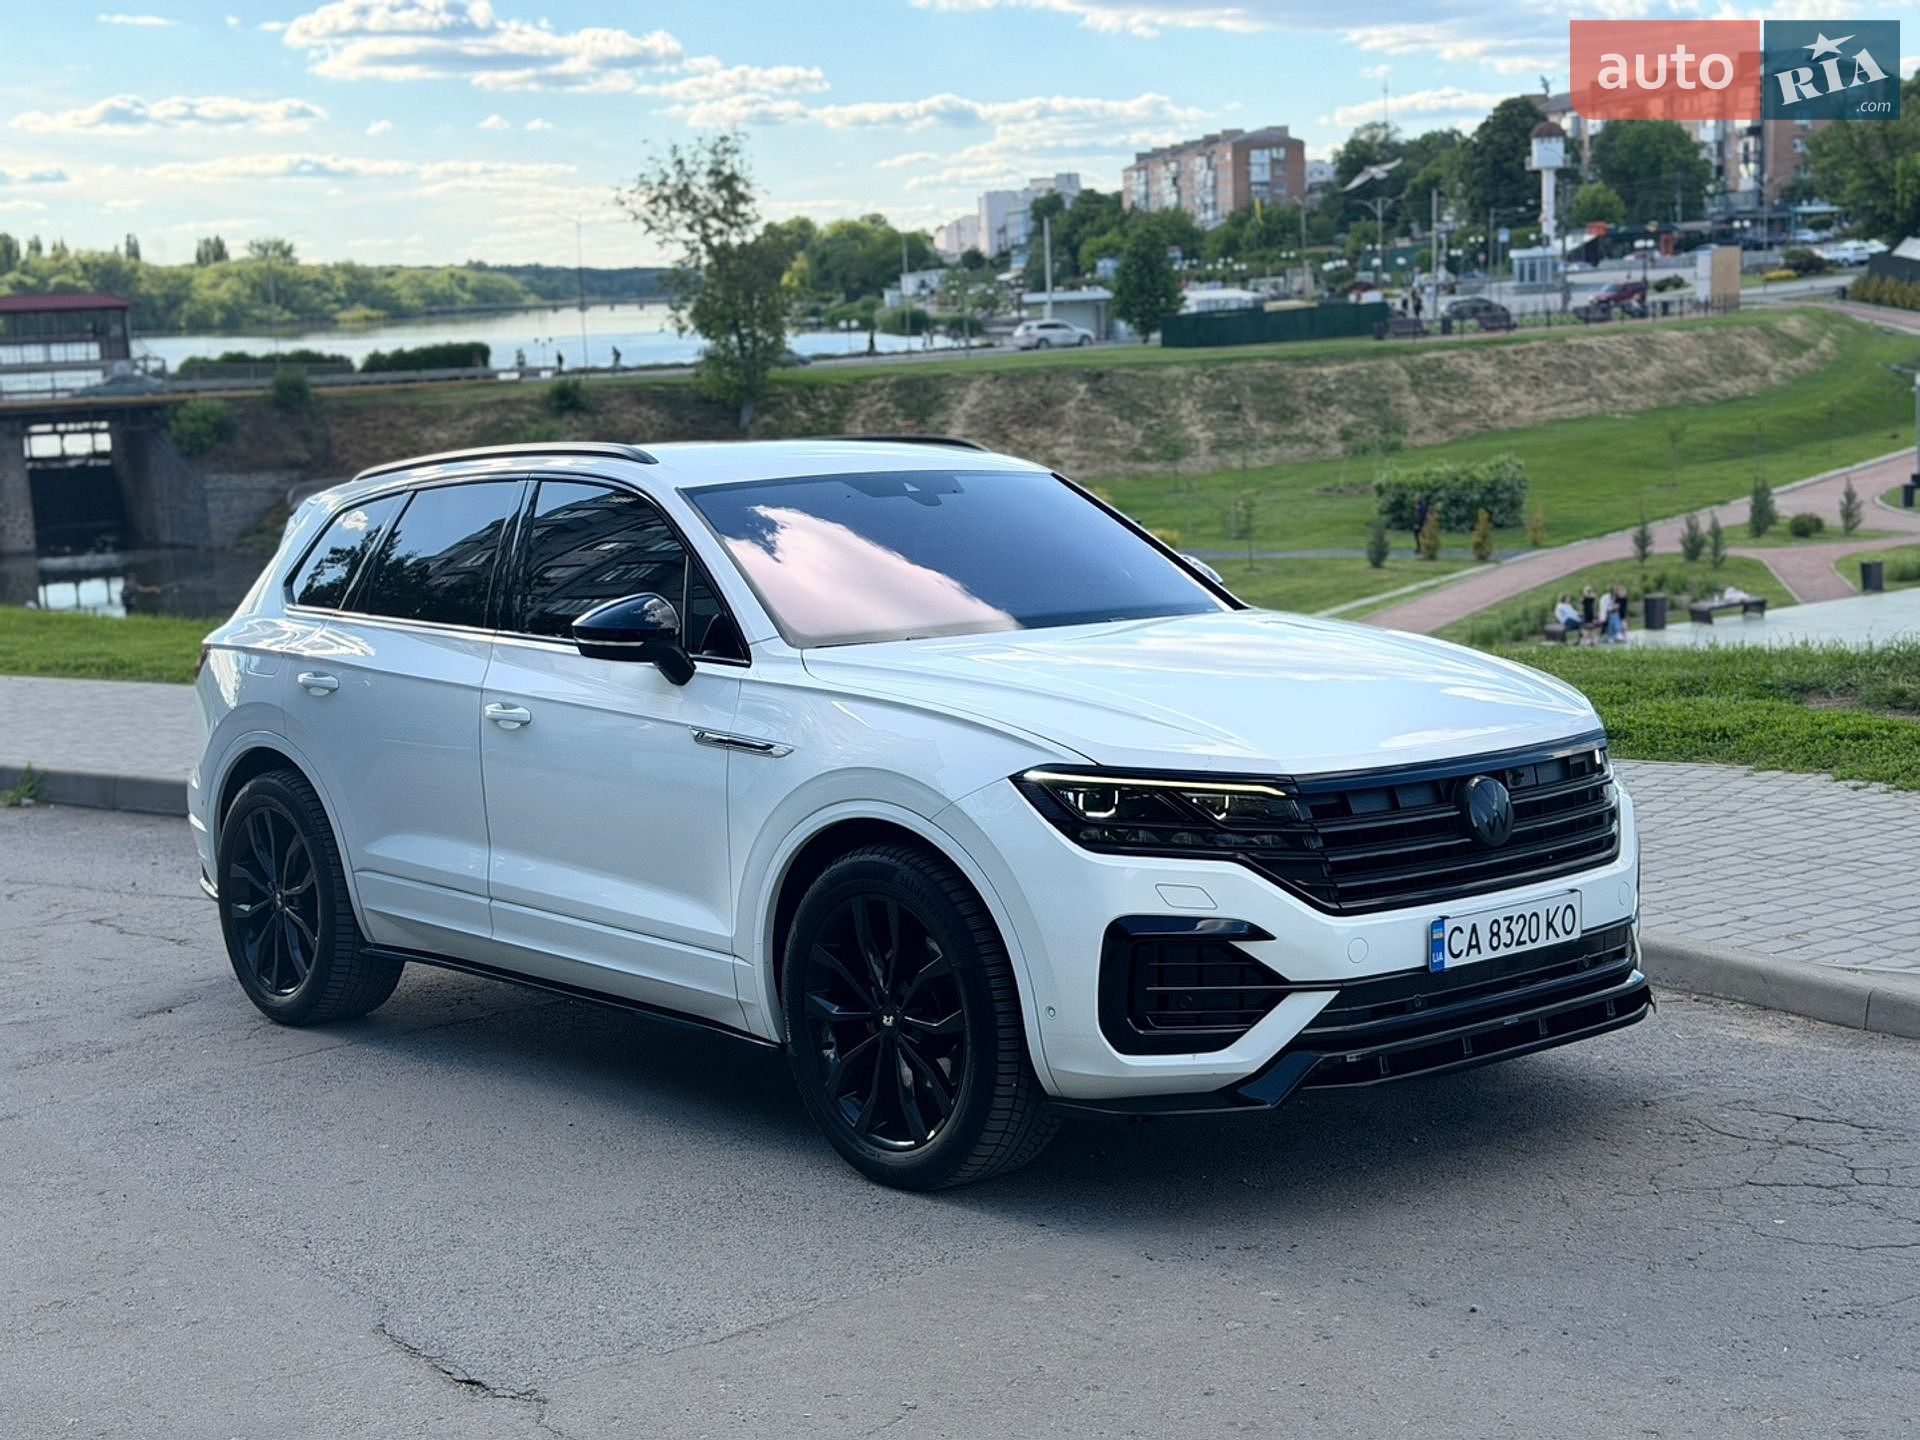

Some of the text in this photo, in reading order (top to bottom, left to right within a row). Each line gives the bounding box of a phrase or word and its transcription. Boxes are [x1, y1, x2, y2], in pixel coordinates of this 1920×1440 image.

[1447, 904, 1576, 959] CA 8320 KO
[1432, 953, 1443, 963] UA
